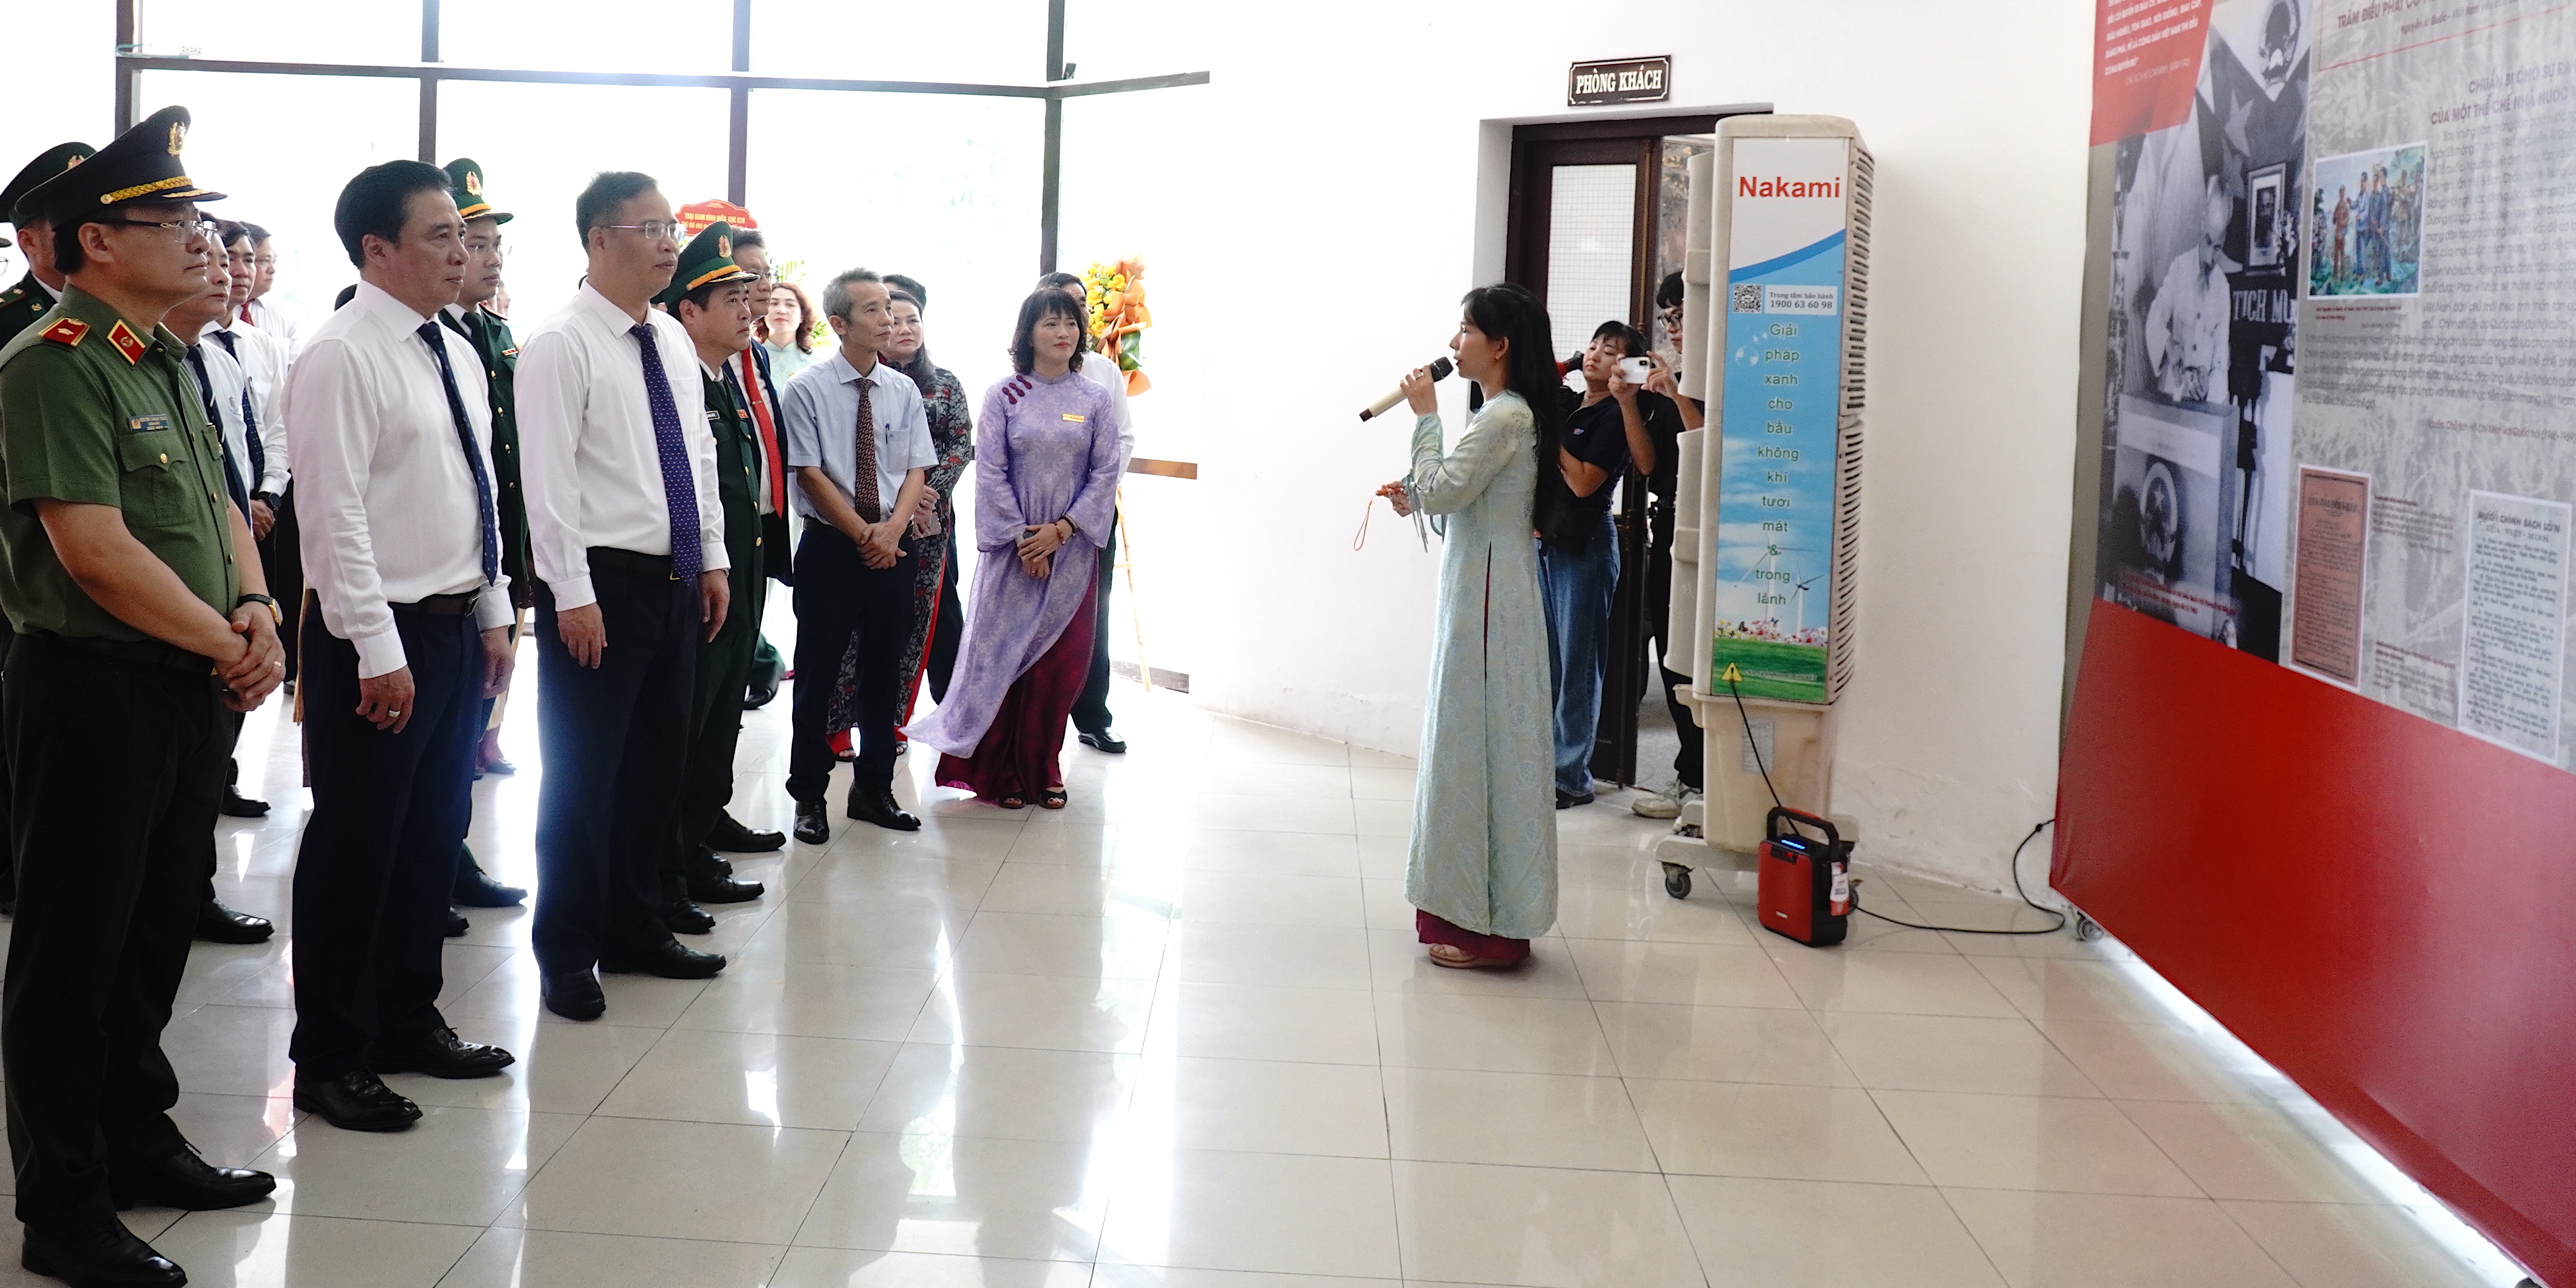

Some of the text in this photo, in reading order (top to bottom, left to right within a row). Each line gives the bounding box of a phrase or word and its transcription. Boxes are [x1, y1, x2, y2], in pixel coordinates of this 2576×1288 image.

[1576, 64, 1663, 94] PHÒNG KHÁCH
[1739, 176, 1840, 197] Nakami
[1770, 300, 1792, 308] 1900
[1795, 300, 1805, 308] 63
[1770, 323, 1797, 336] Giải
[1765, 349, 1799, 362] pháp
[1764, 374, 1798, 385] xanh
[1768, 398, 1792, 410] cho
[1767, 420, 1792, 434] bầu
[1758, 446, 1799, 461] không
[1767, 471, 1787, 483] khí
[1762, 495, 1790, 507] tươi
[1763, 520, 1788, 532] mát
[1769, 545, 1778, 556] &
[1756, 568, 1790, 583] trong
[1758, 593, 1786, 605] lành
